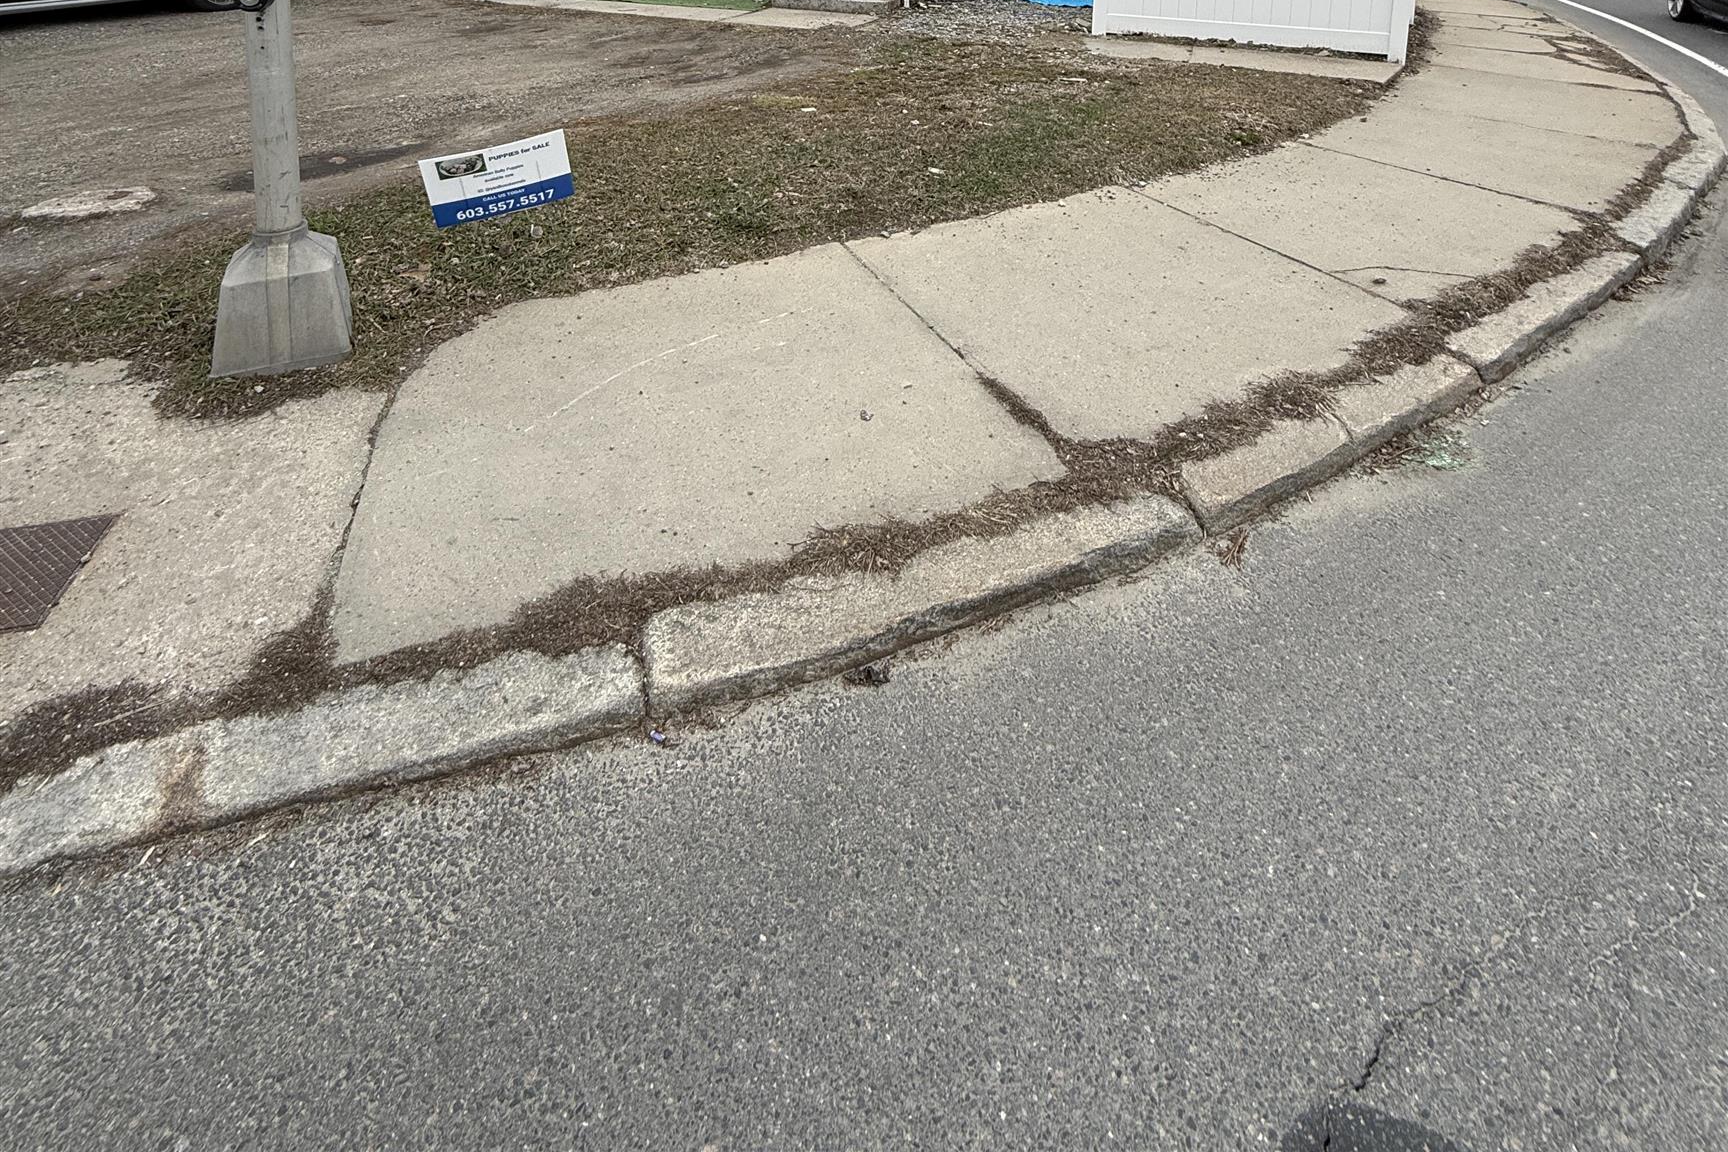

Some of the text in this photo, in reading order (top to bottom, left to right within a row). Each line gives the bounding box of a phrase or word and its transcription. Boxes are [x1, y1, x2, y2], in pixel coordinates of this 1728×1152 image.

[488, 151, 519, 161] PUPPIES
[532, 142, 550, 151] SALE
[456, 189, 554, 220] 603.557.5517
[482, 194, 498, 202] CALL
[507, 188, 526, 196] TODAY
